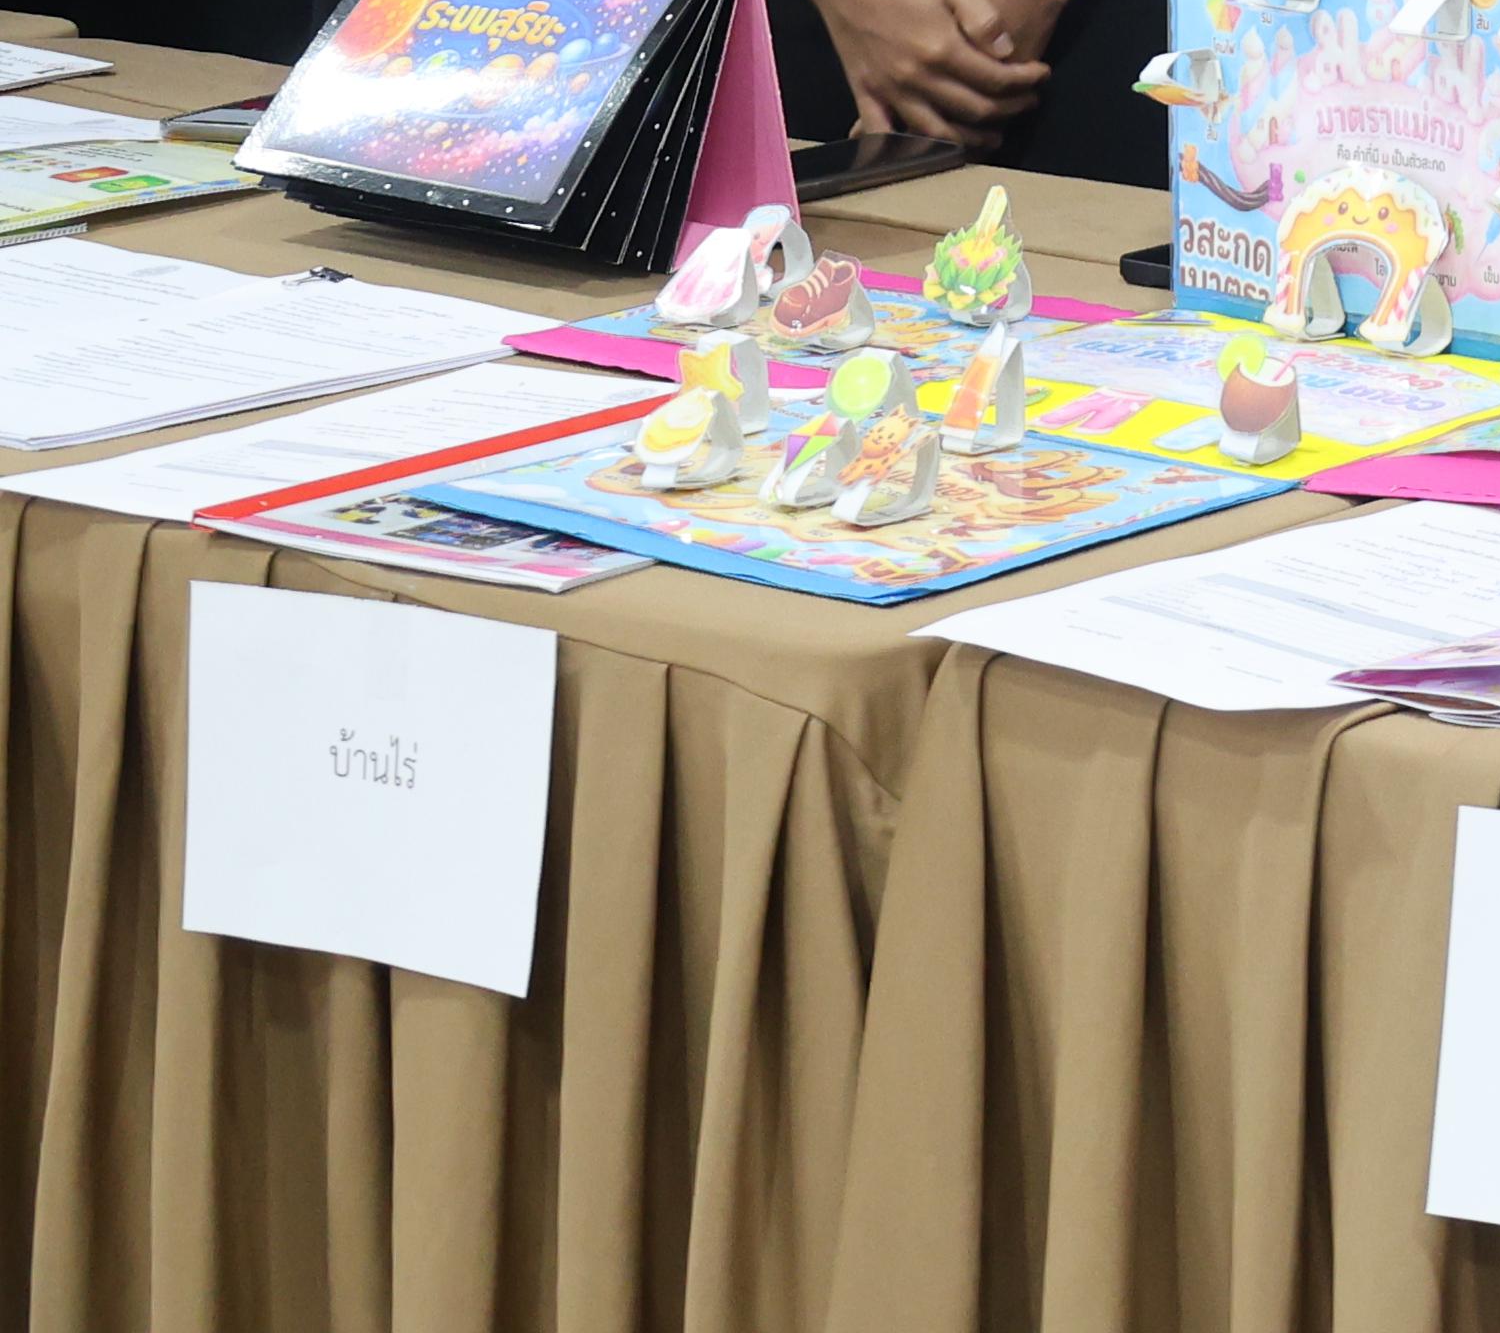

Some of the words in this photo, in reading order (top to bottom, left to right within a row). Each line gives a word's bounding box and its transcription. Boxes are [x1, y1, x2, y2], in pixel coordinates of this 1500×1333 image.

[417, 0, 567, 53] ระบบสุริยะ
[1316, 99, 1465, 151] มาตราแม่กม
[329, 726, 419, 790] บ้านไร่
